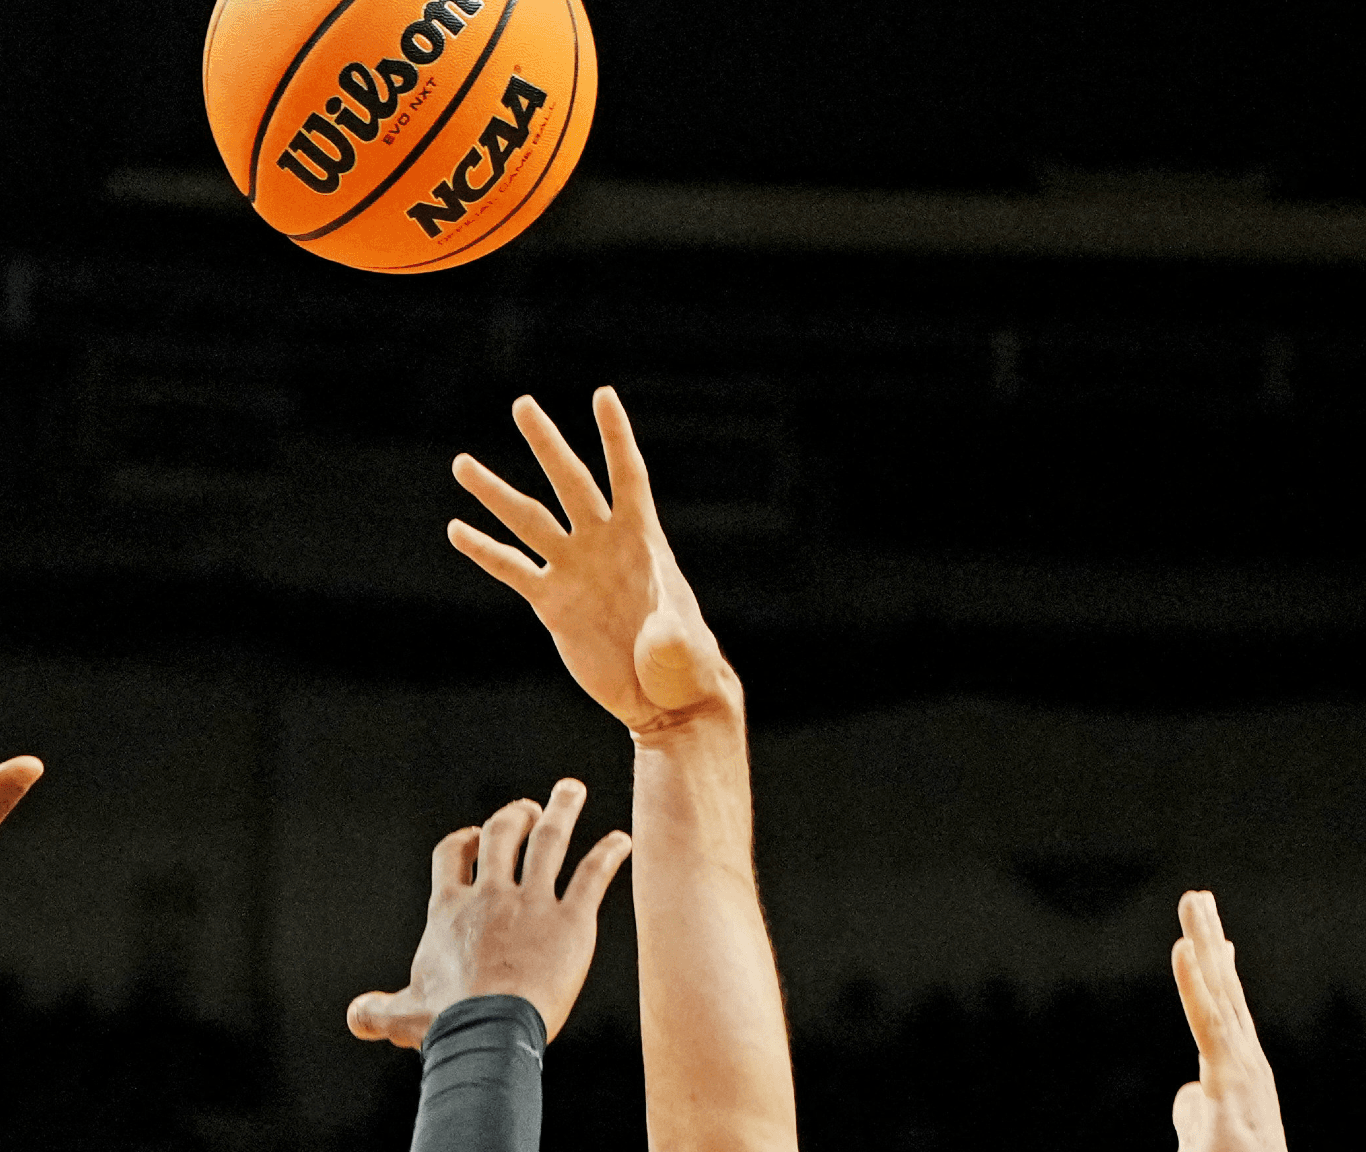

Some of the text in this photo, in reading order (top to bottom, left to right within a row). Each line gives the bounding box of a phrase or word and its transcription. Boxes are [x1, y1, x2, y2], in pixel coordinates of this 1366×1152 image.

[276, 0, 485, 195] Wilson
[382, 76, 437, 146] EVO NXT
[405, 74, 548, 239] NCAA
